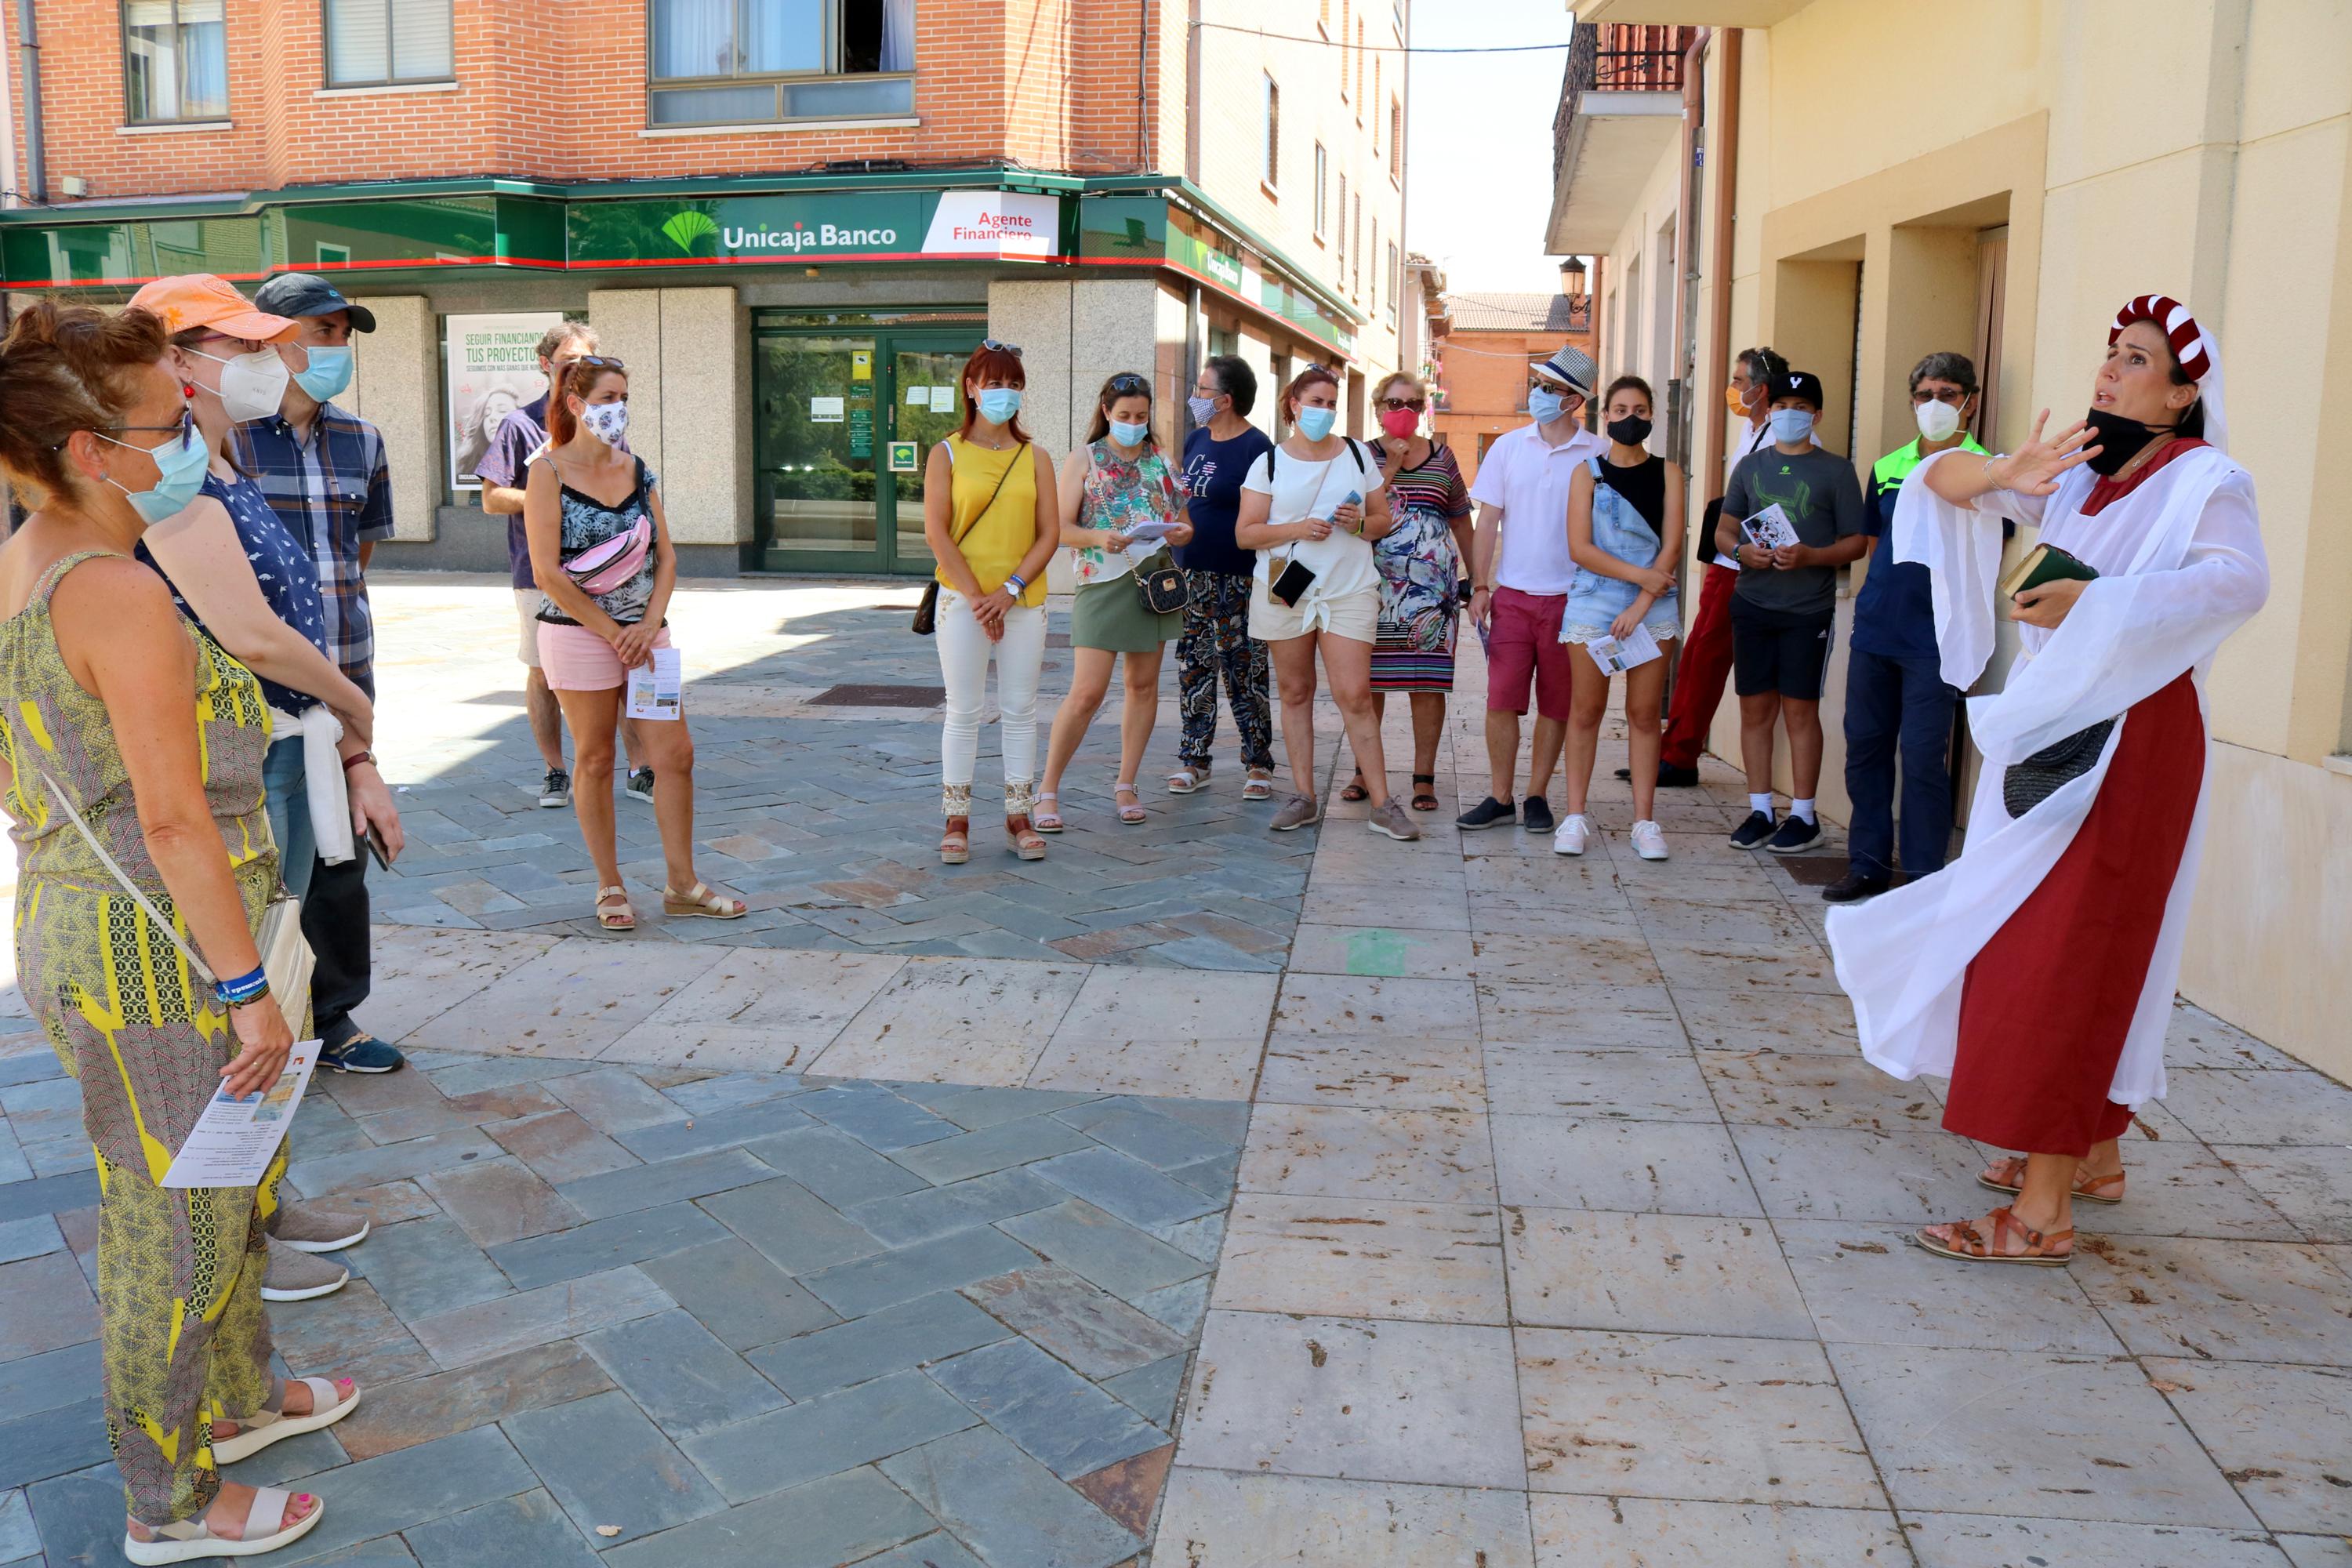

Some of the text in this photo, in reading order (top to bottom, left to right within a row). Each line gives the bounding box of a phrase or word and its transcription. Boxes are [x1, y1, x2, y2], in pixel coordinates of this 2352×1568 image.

[978, 212, 1033, 229] Agente
[724, 221, 897, 253] Unicaja Banco
[953, 226, 1033, 241] Financiero
[465, 333, 492, 346] SEGUIR
[466, 347, 539, 363] TUS PROYECTO
[1790, 376, 1802, 388] Y
